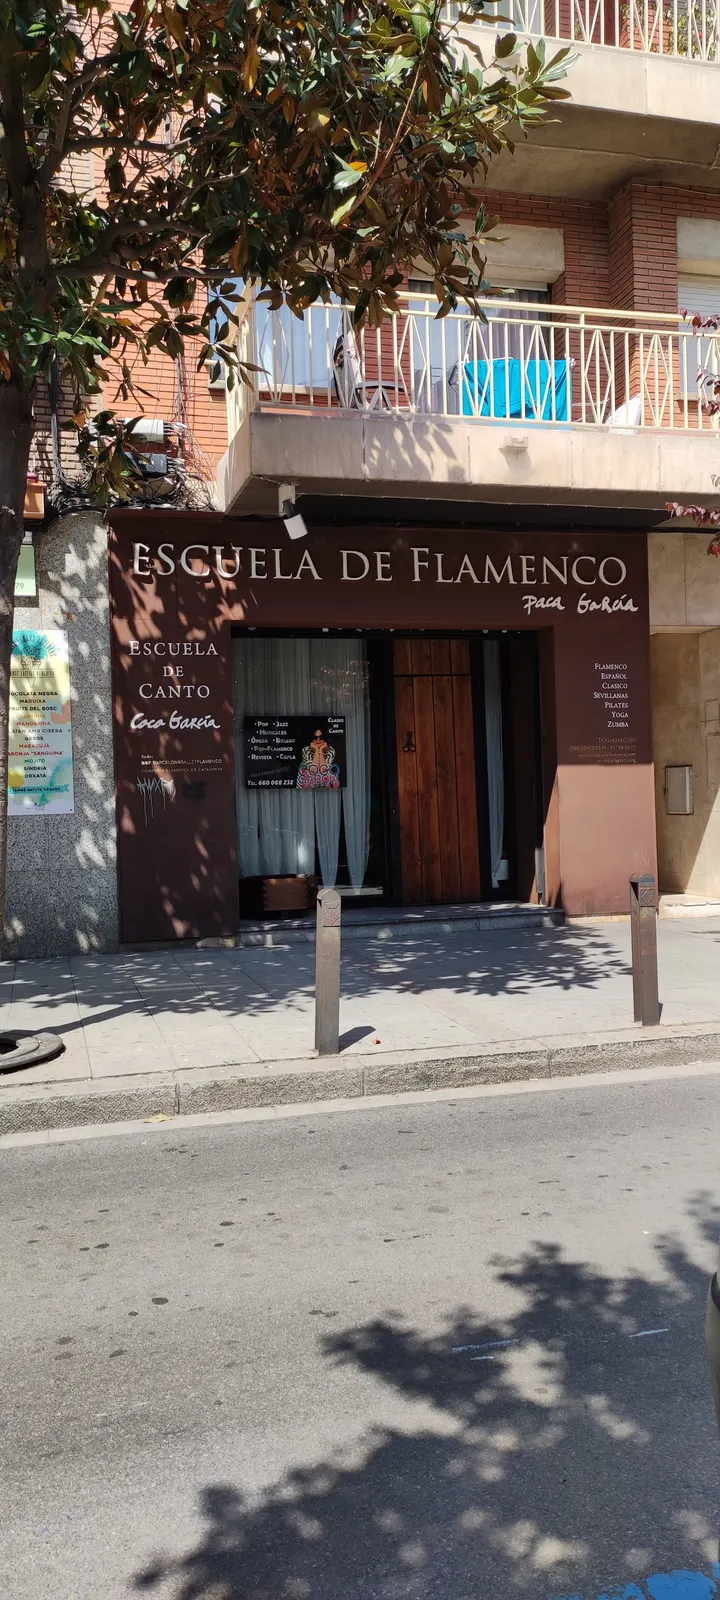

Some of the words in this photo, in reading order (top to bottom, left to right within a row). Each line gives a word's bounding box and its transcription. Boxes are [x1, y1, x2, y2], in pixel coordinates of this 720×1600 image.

[132, 542, 323, 580] ESCUELA
[340, 550, 393, 582] DE
[410, 547, 627, 586] FLAMENCO
[128, 640, 219, 656] ESCUELA
[163, 665, 184, 677] DE
[594, 662, 628, 670] FLAMENCO
[601, 672, 628, 680] ESPAÑOL
[602, 681, 628, 689] CLASICO
[138, 683, 210, 699] CANTO
[593, 691, 628, 699] SEVILLANAS
[130, 712, 165, 730] Coco
[607, 720, 629, 728] ZUMBA
